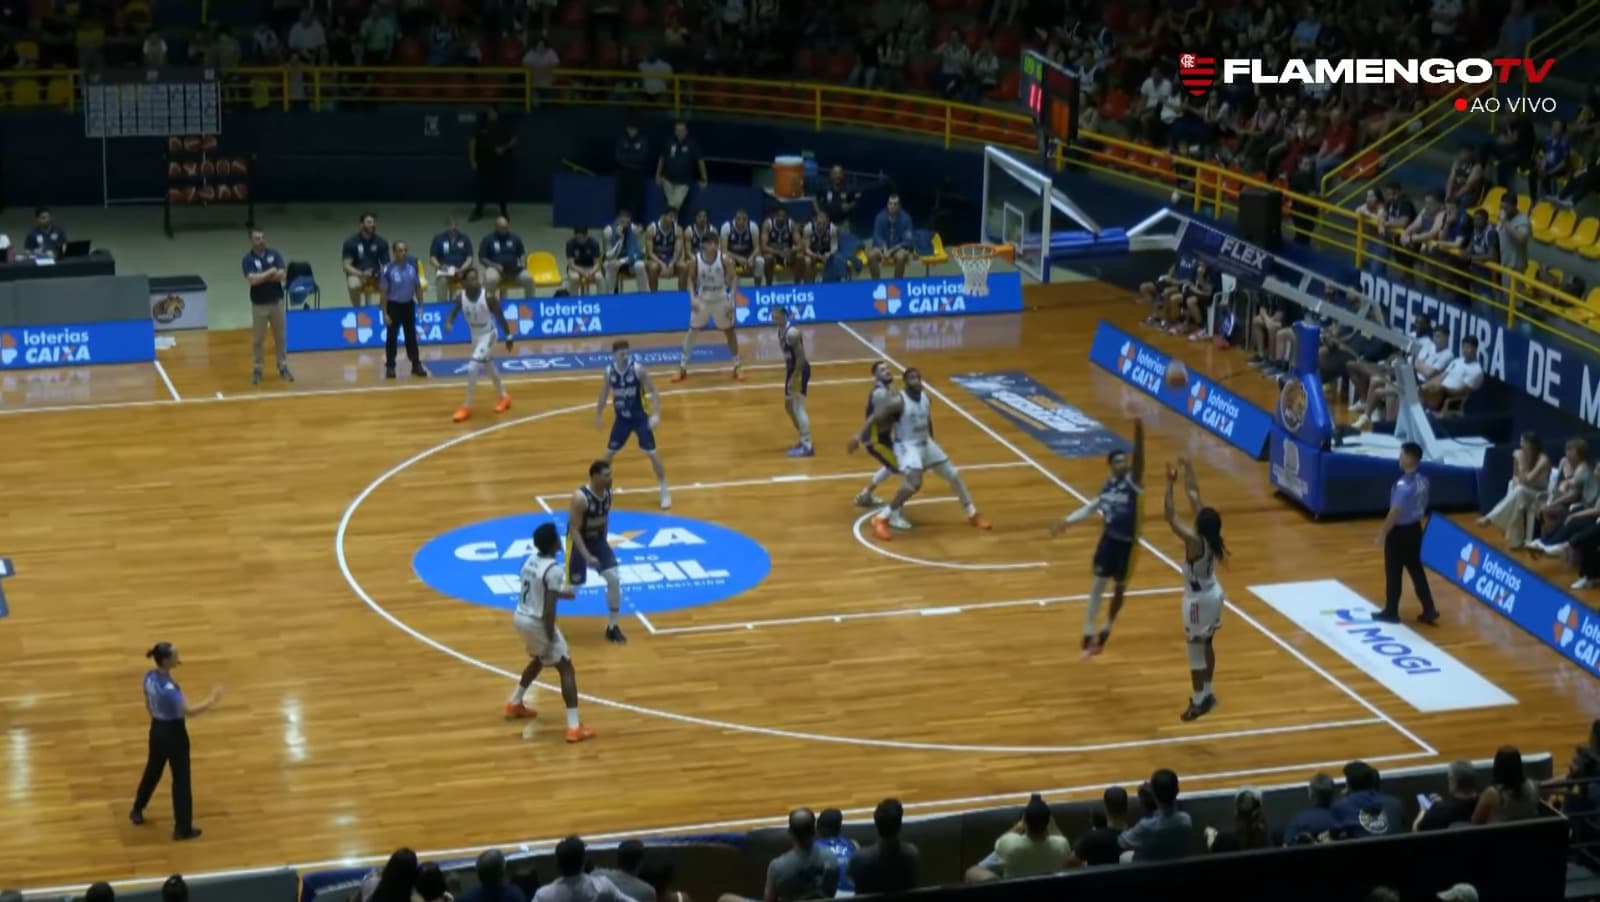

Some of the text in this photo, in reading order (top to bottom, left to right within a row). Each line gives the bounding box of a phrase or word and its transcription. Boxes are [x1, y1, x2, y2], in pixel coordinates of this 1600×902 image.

[1220, 234, 1267, 270] FLEX
[755, 288, 815, 305] loterias
[907, 279, 965, 297] loterias
[539, 299, 601, 318] loterias
[757, 303, 816, 322] CXA
[908, 295, 966, 313] CAIXA
[23, 327, 89, 346] loterias
[541, 315, 603, 334] CAIXA
[25, 344, 91, 363] CAIXA
[1136, 347, 1166, 376] loterias
[1132, 365, 1161, 395] CAIXA
[1525, 339, 1563, 408] DE
[1207, 389, 1240, 420] loterias
[1202, 407, 1235, 438] CAIXA
[454, 527, 707, 561] CAXA
[1481, 553, 1522, 593] loterias
[1475, 575, 1516, 614] CAIXA
[1346, 627, 1442, 675] MOGI
